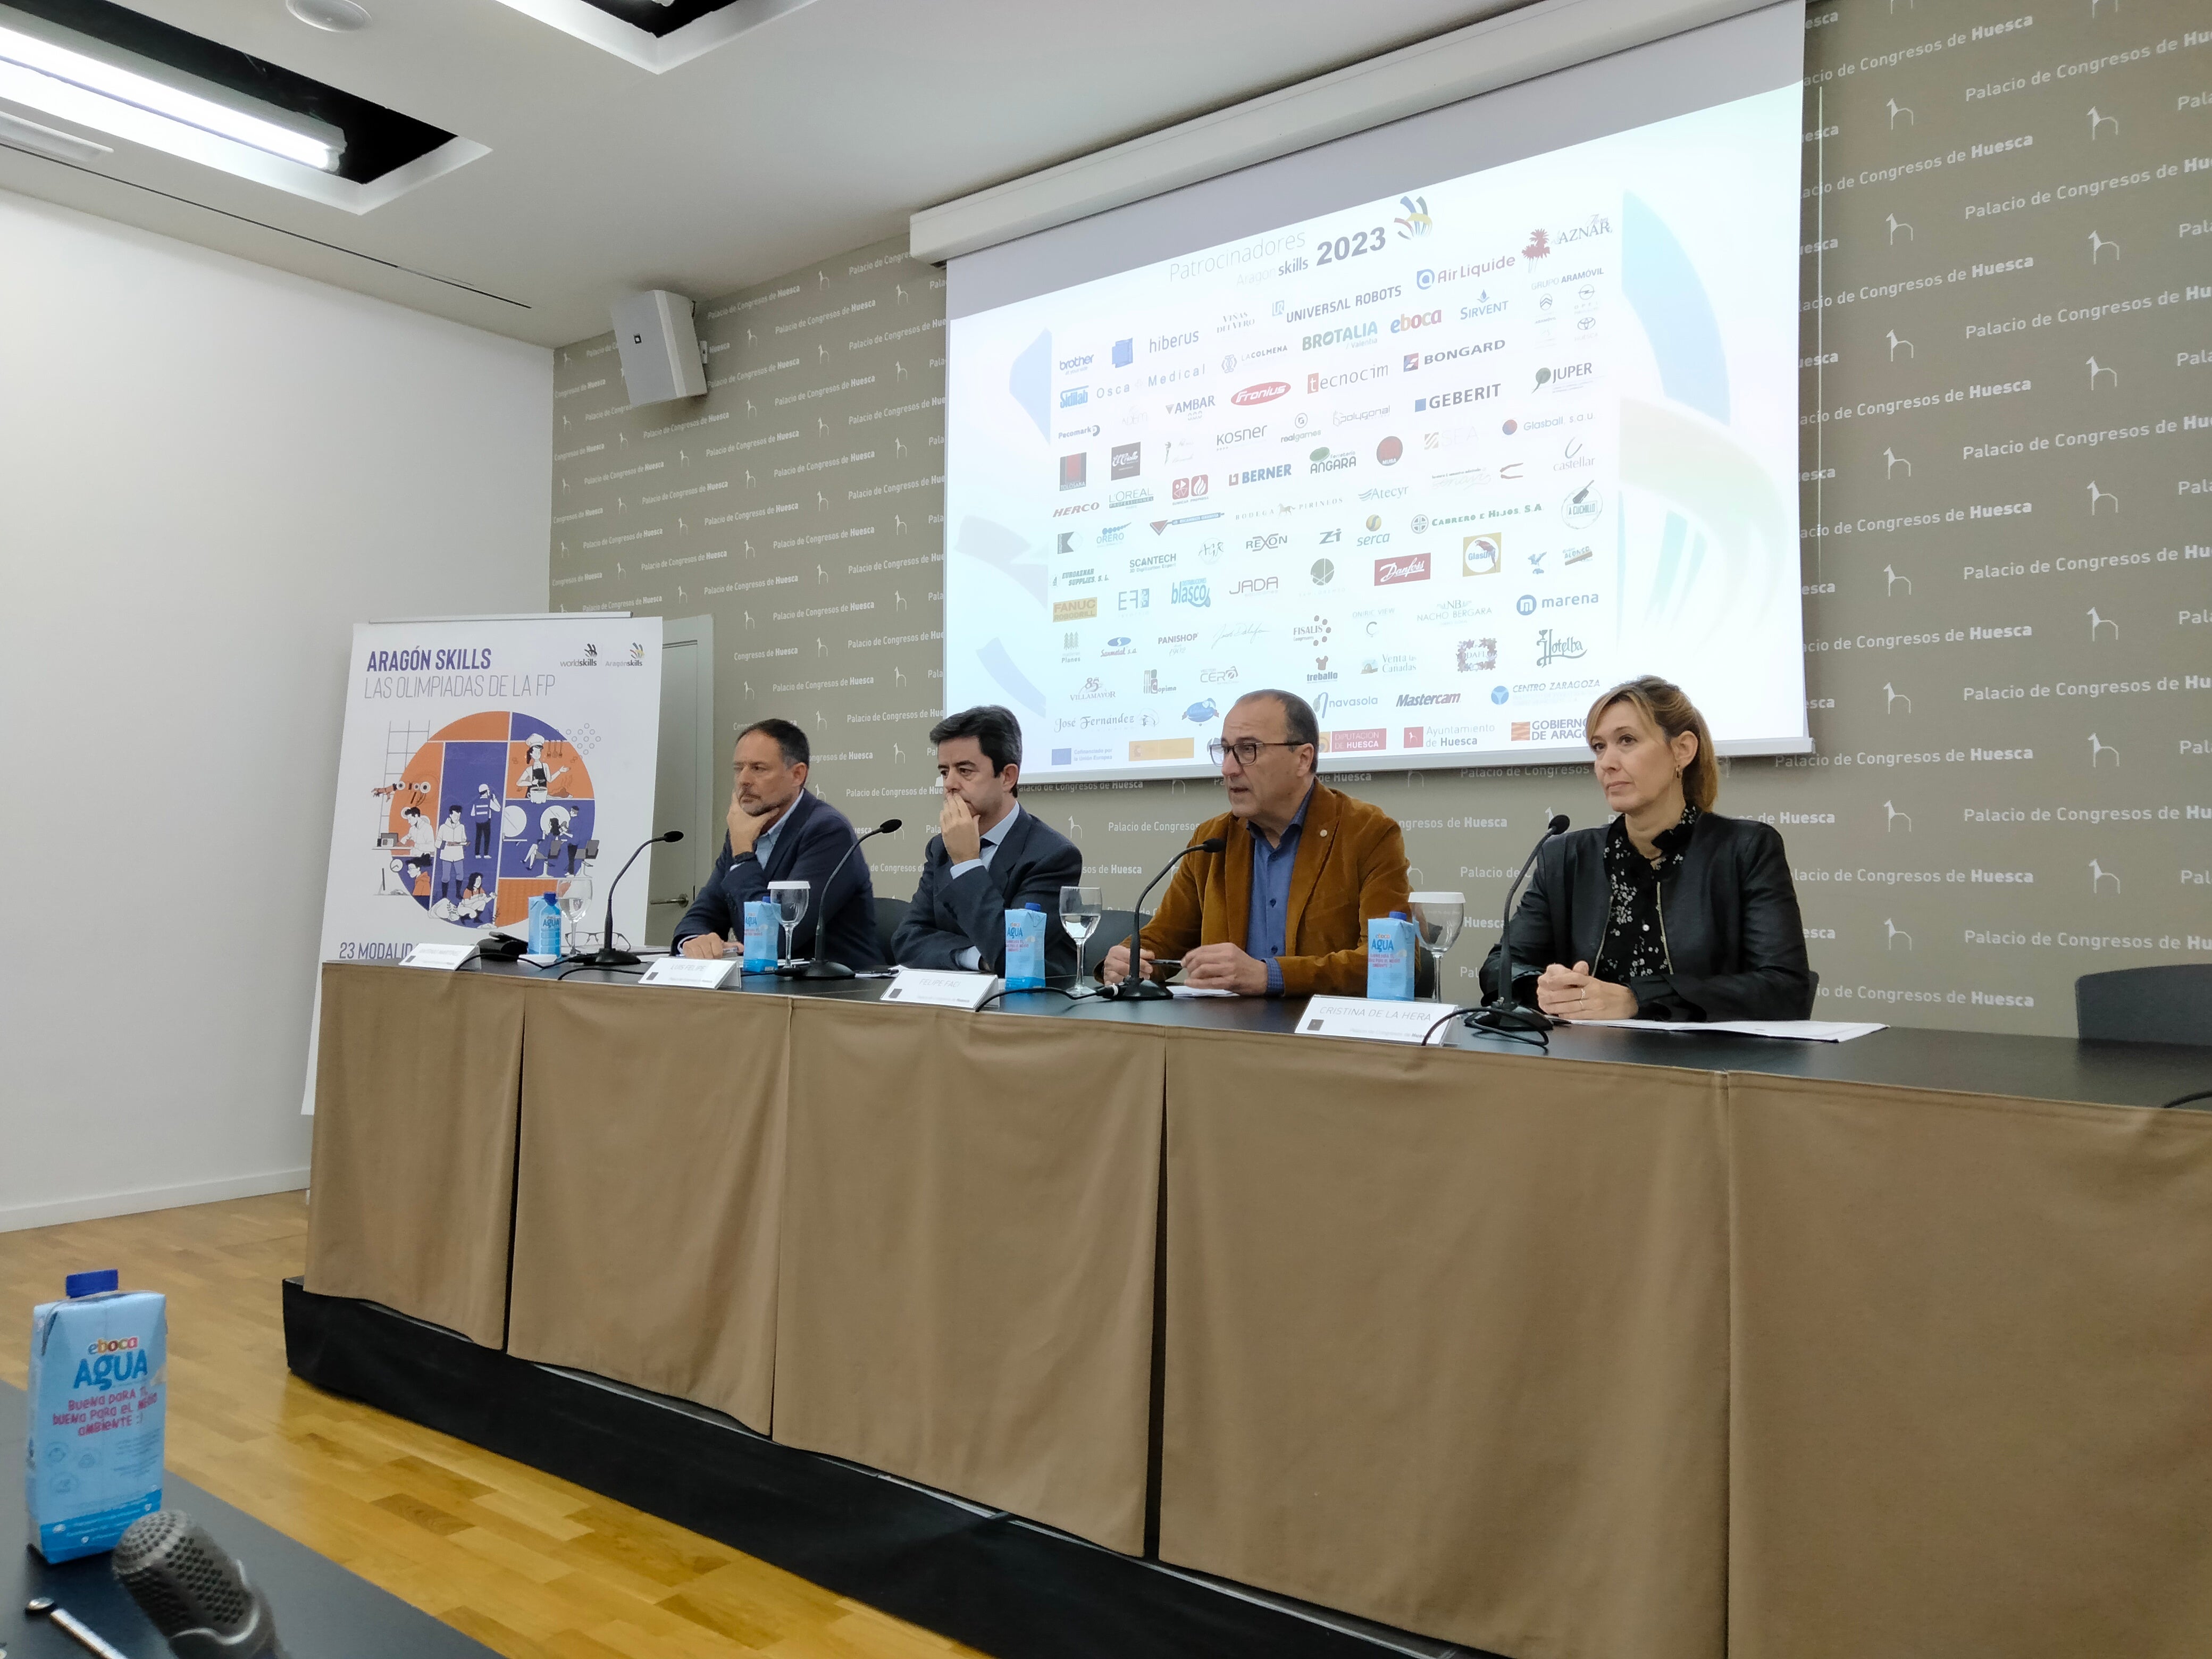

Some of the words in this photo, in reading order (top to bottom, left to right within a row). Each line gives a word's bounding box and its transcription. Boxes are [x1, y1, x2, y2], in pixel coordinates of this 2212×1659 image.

[1838, 64, 1855, 77] de
[1861, 40, 1942, 70] Congresos
[1948, 33, 1966, 47] de
[1972, 15, 2033, 40] Huesca
[1966, 78, 2025, 101] Palacio
[2031, 71, 2051, 85] de
[2057, 47, 2150, 78] Congresos
[2156, 39, 2178, 53] de
[1170, 232, 1305, 282] Patrocinadores
[1278, 257, 1309, 276] skills
[1317, 227, 1386, 266] 2023
[1438, 269, 1457, 283] Air
[1461, 255, 1515, 278] Liquide
[1531, 278, 1559, 290] GRUPO
[1561, 267, 1604, 283] ARAMÓVIL
[1287, 298, 1351, 323] UNIVERSAL
[1355, 286, 1402, 306] ROBOTS
[1390, 309, 1442, 333] eboca
[1150, 331, 1199, 353] hiberus
[1302, 321, 1378, 351] BROTALIA
[1425, 339, 1505, 365] BONGARD
[1060, 354, 1094, 371] brother
[1097, 384, 1130, 398] Osca
[1148, 364, 1205, 387] Medical
[1310, 364, 1388, 391] tecnocim
[1553, 362, 1592, 384] JUPER
[775, 396, 797, 406] Palacio
[807, 384, 840, 398] Congresos
[851, 375, 875, 387] Huesca
[1236, 385, 1287, 403] Fronius
[1429, 383, 1501, 409] GEBERIT
[1175, 395, 1216, 414] AMBAR
[1059, 427, 1092, 439] Pecomark
[1963, 440, 2024, 459] Palacio
[2029, 437, 2049, 450] de
[2055, 425, 2150, 447] Congresos
[2155, 420, 2178, 433] de
[774, 468, 796, 477] Palacio
[807, 458, 840, 471] Congresos
[851, 451, 875, 462] Huesca
[1310, 456, 1356, 474] ANGARA
[1553, 456, 1595, 472] castellar
[1242, 464, 1291, 484] BERNER
[1371, 486, 1409, 501] Atecyr
[1053, 502, 1099, 518] HERCO
[1431, 514, 1476, 526] CABRERO
[1096, 532, 1124, 544] ORERO
[1357, 533, 1390, 547] serca
[1129, 553, 1177, 568] SCANTECH
[1380, 557, 1425, 582] Danfoss
[1171, 580, 1211, 608] blasco
[1229, 576, 1278, 595] JADA
[1054, 599, 1096, 613] FANUC
[1541, 593, 1599, 608] marena
[1053, 610, 1095, 622] ROBODRILL
[1417, 611, 1448, 622] NACHO
[1453, 607, 1492, 618] BERGARA
[1158, 633, 1197, 644] PANISHOP
[367, 646, 432, 672] ARAGÓN
[435, 648, 491, 671] SKILLS
[560, 658, 597, 667] worldskills
[1382, 653, 1406, 663] Venta
[364, 677, 393, 699] LAS
[396, 676, 484, 698] OLIMPIADAS
[488, 675, 508, 697] DE
[512, 675, 531, 697] LA
[536, 674, 556, 696] FP
[806, 681, 839, 690] Congresos
[1513, 683, 1546, 693] CENTRO
[1549, 679, 1600, 690] ZARAGOZA
[1329, 697, 1378, 708] navasola
[1396, 693, 1461, 707] Mastercam
[1054, 718, 1076, 733] José
[1426, 725, 1495, 736] Ayuntamiento
[1426, 739, 1437, 748] de
[1440, 738, 1477, 747] Huesca
[1532, 731, 1547, 740] DE
[1857, 752, 1940, 767] Congresos
[1946, 749, 1965, 761] de
[1971, 748, 2033, 761] Huesca
[1964, 808, 2025, 822] Palacio
[2031, 808, 2051, 820] de
[2056, 807, 2152, 824] Congresos
[2157, 806, 2180, 820] de
[1857, 869, 1941, 885] Congresos
[1946, 869, 1965, 882] de
[1971, 869, 2034, 883] Huesca
[339, 942, 355, 959] 23
[1320, 1007, 1365, 1016] CRISTINA
[1402, 1012, 1431, 1021] HERA
[88, 1336, 138, 1355] eboca
